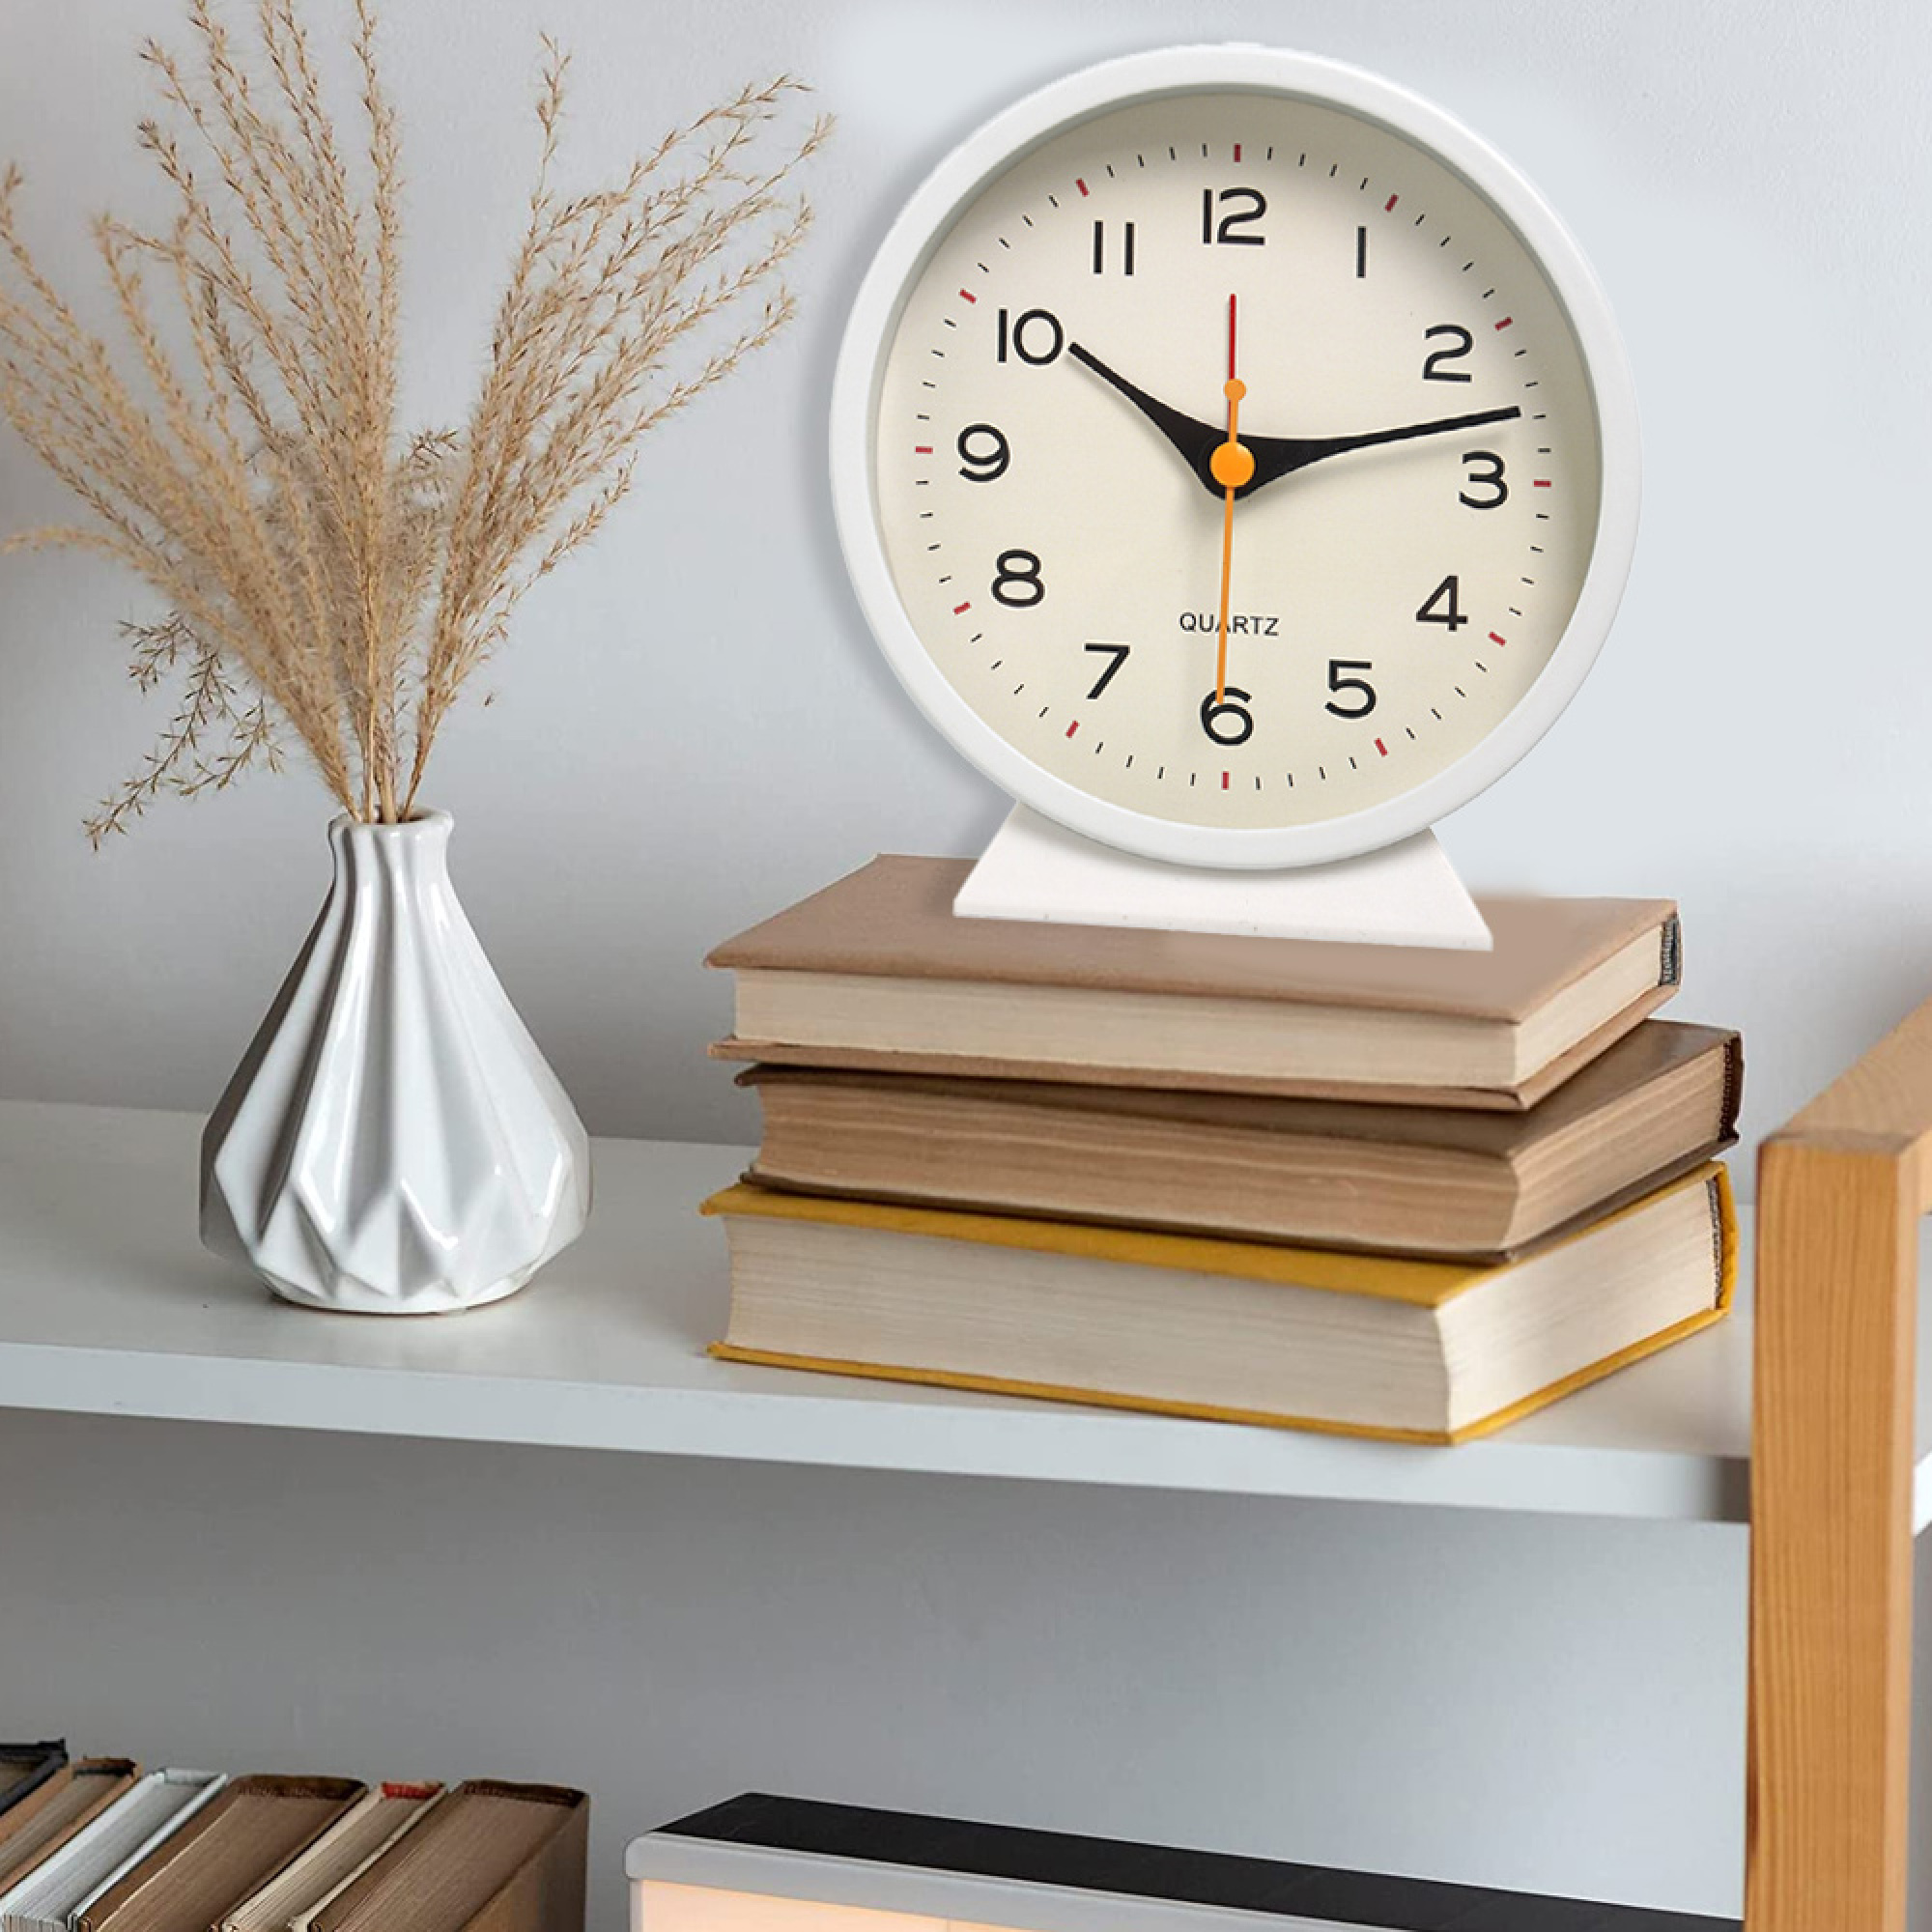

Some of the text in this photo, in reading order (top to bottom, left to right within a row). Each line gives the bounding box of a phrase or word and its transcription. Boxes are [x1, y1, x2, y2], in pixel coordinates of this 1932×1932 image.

[1203, 186, 1266, 246] 12
[1093, 220, 1135, 275] 11
[1357, 225, 1368, 279] 1
[997, 308, 1064, 366] 10
[1422, 324, 1474, 384] 2
[957, 424, 1009, 482] 9
[1459, 451, 1508, 510] 3
[991, 550, 1044, 608] 8
[1415, 575, 1467, 633] 4
[1084, 642, 1129, 701] 7
[1324, 659, 1378, 720] 5
[1200, 686, 1254, 747] 6
